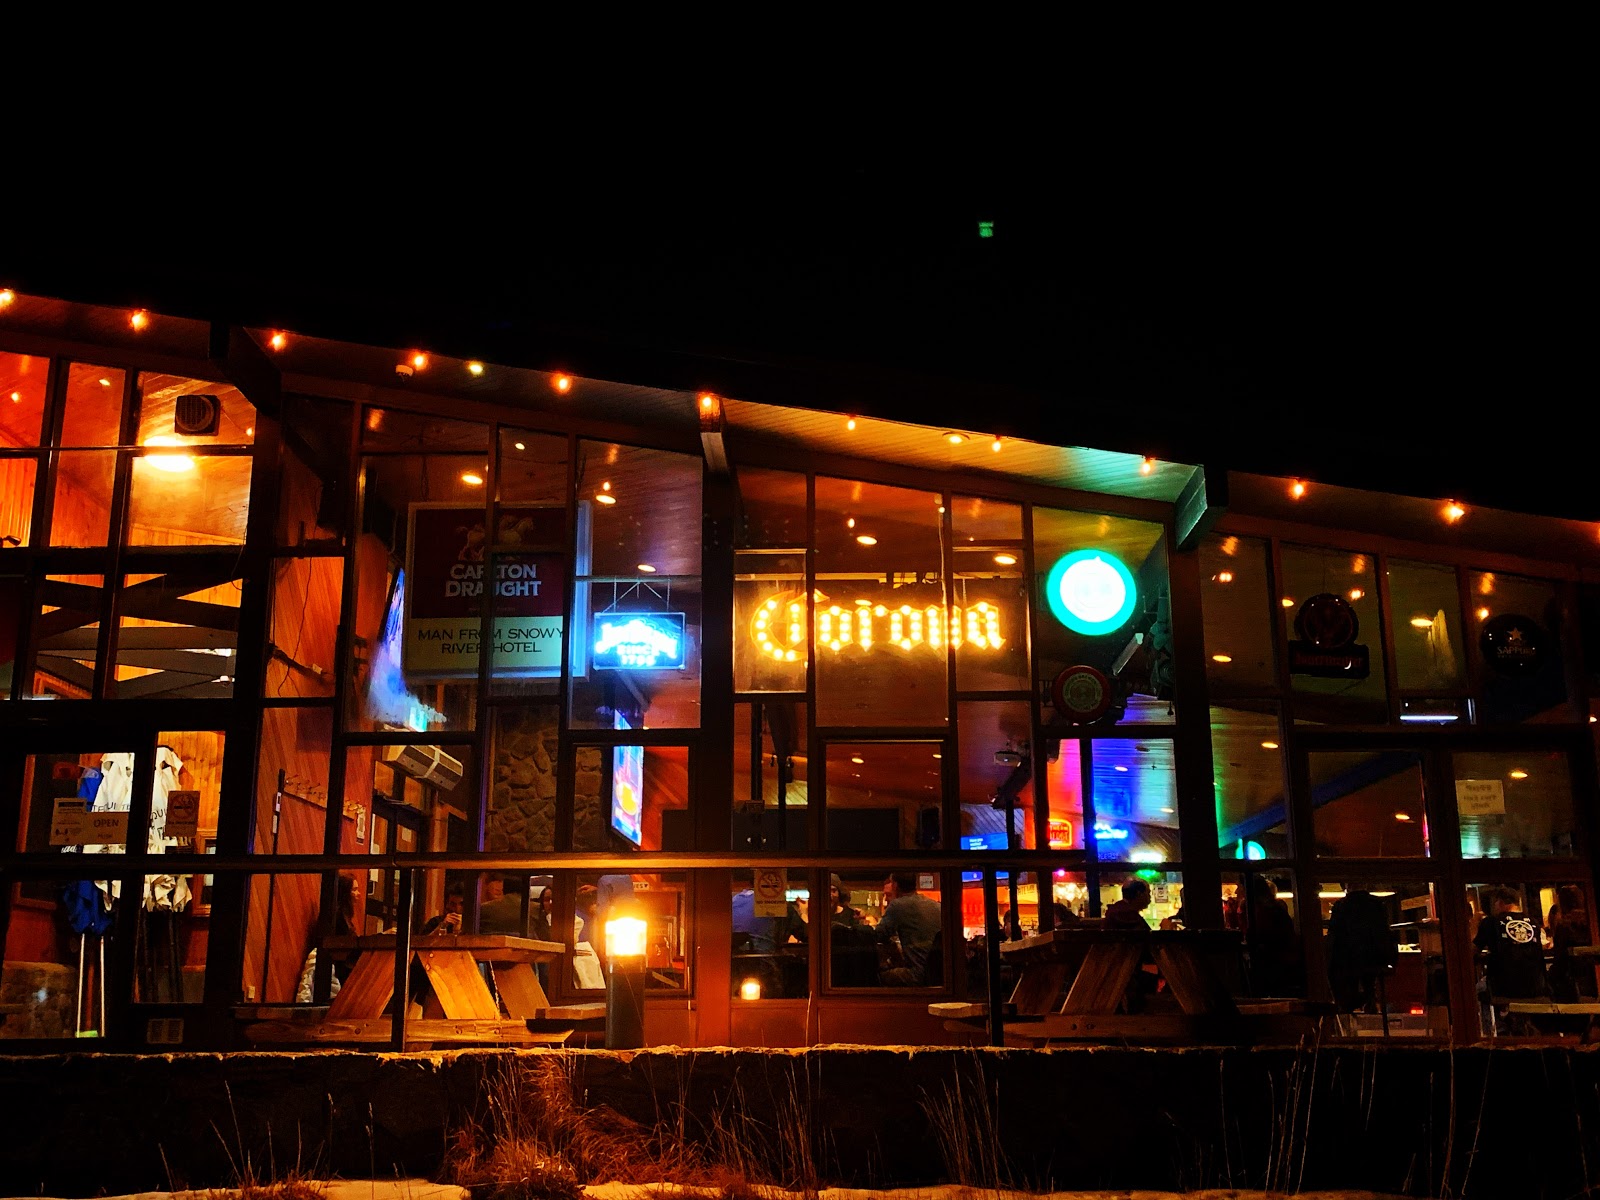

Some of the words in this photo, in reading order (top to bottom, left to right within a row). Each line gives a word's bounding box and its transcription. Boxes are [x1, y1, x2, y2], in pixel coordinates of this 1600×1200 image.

[449, 563, 537, 580] CARTON
[445, 580, 542, 597] DRAGHT
[750, 588, 1007, 662] Corona
[418, 629, 453, 640] MAN
[459, 628, 502, 641] FRM
[507, 628, 566, 639] SNOWY
[493, 641, 542, 653] HOTEL
[94, 818, 120, 828] OPEN
